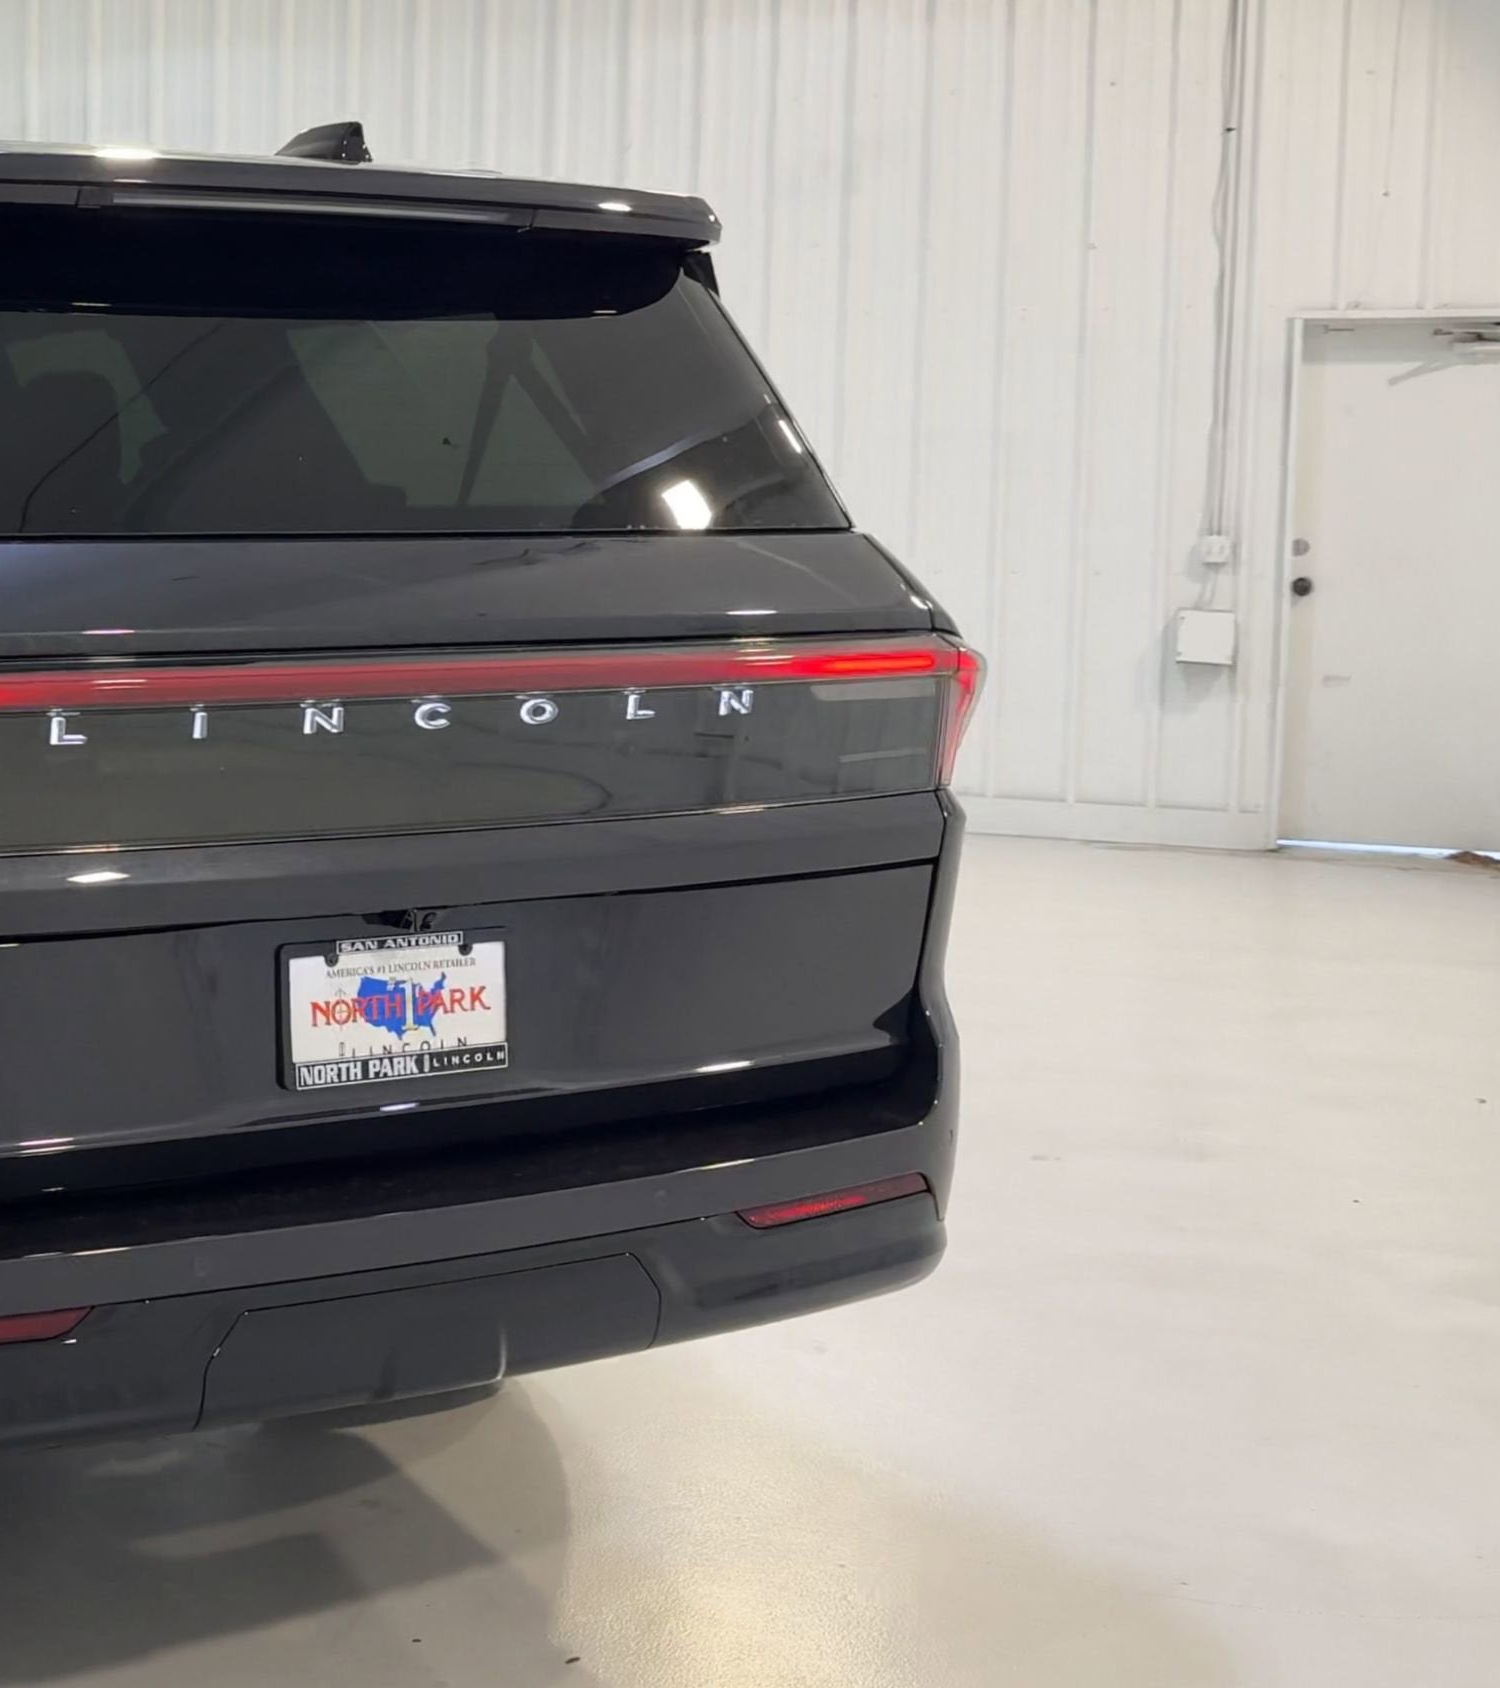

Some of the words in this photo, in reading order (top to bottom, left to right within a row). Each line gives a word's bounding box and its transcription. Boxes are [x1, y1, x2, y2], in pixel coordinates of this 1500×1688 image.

[48, 688, 754, 745] LINCOLN
[340, 940, 378, 952] SAN
[383, 934, 460, 948] ANTONIO
[326, 965, 375, 979] AMERICA'S
[388, 961, 431, 973] LINCOLN
[433, 957, 477, 969] RETAILER
[310, 992, 402, 1028] NORTH
[416, 985, 491, 1017] PARK
[300, 1060, 362, 1086] NORTH
[368, 1055, 419, 1079] PARK
[432, 1048, 505, 1068] LINCOLN
